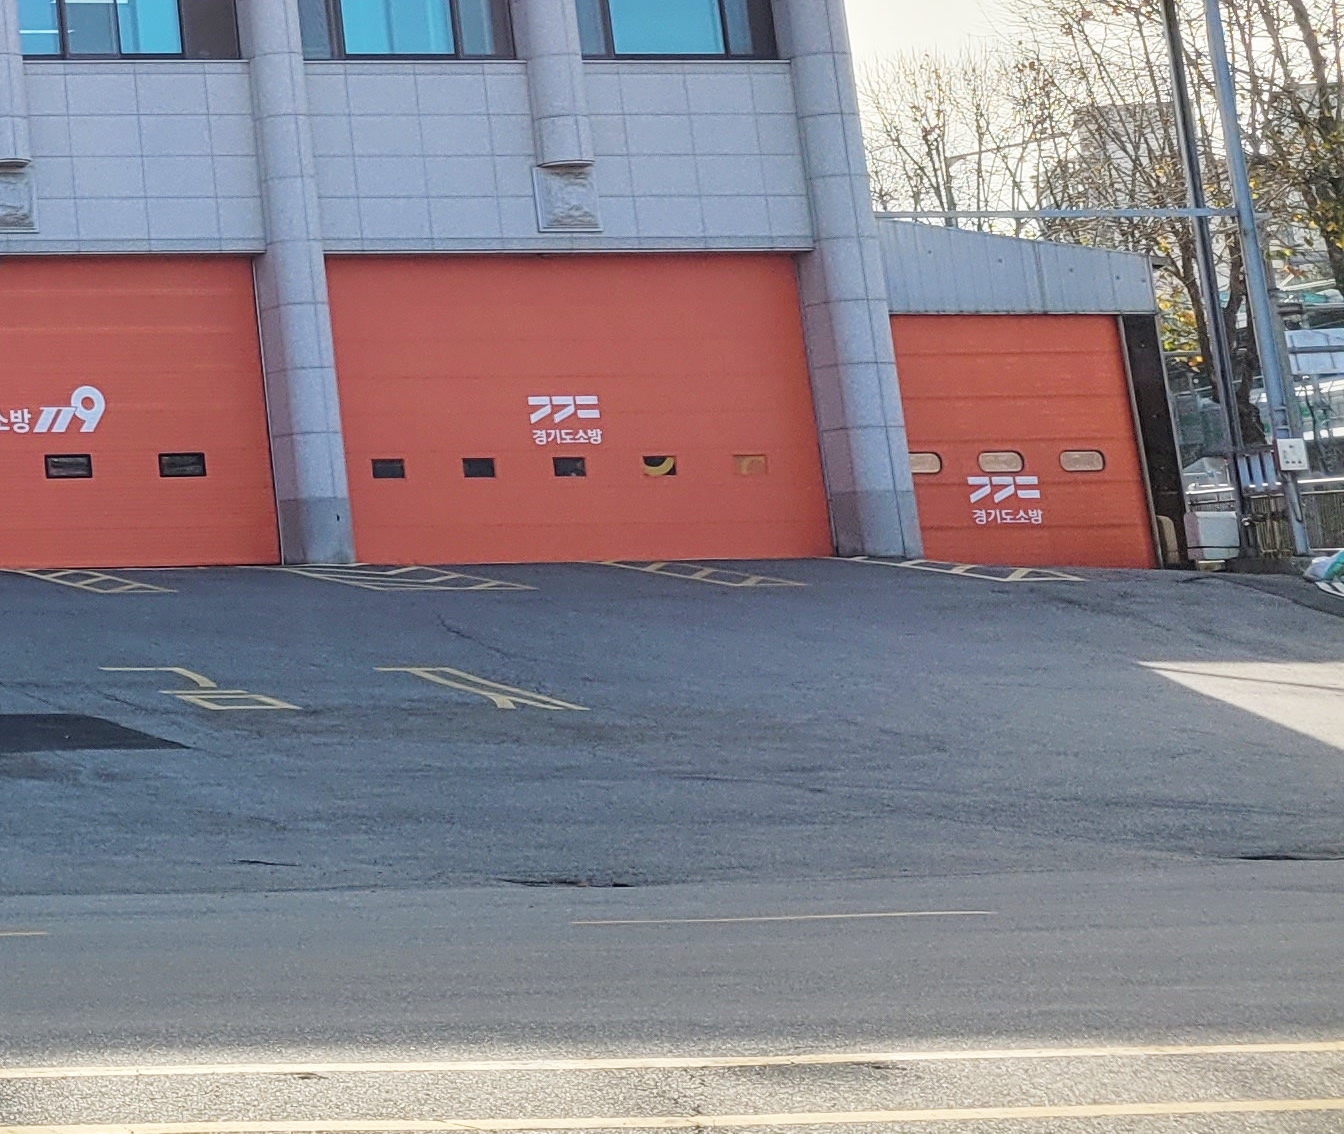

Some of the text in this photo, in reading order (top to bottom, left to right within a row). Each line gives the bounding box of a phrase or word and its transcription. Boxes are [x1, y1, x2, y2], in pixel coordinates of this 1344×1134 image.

[33, 384, 106, 433] 119
[532, 428, 603, 446] 경기도소방
[972, 509, 1044, 526] 경기도소방
